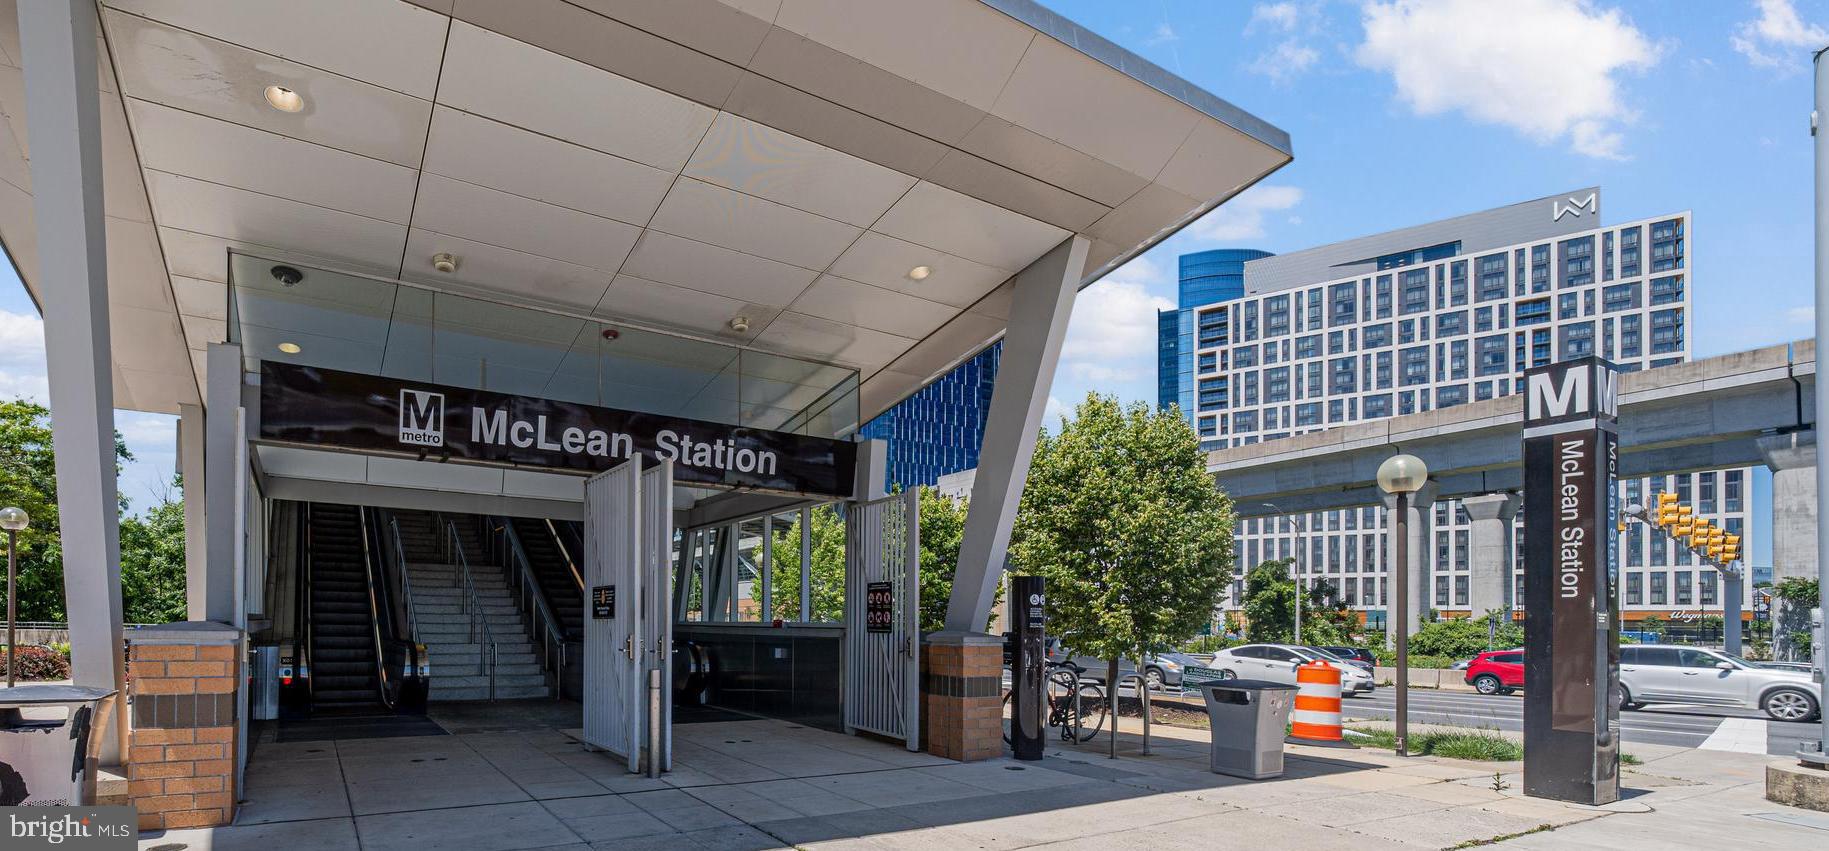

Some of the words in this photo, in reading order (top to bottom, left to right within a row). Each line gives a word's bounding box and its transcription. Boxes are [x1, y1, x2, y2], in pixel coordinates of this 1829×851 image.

[402, 391, 442, 433] M
[1529, 365, 1589, 420] M
[1597, 365, 1618, 417] M
[401, 431, 441, 445] metro
[471, 406, 633, 459] McLean
[654, 429, 777, 476] Station
[1561, 439, 1584, 521] McLean
[1609, 441, 1617, 521] McLean
[1561, 527, 1584, 598] Station
[1609, 527, 1617, 598] Station
